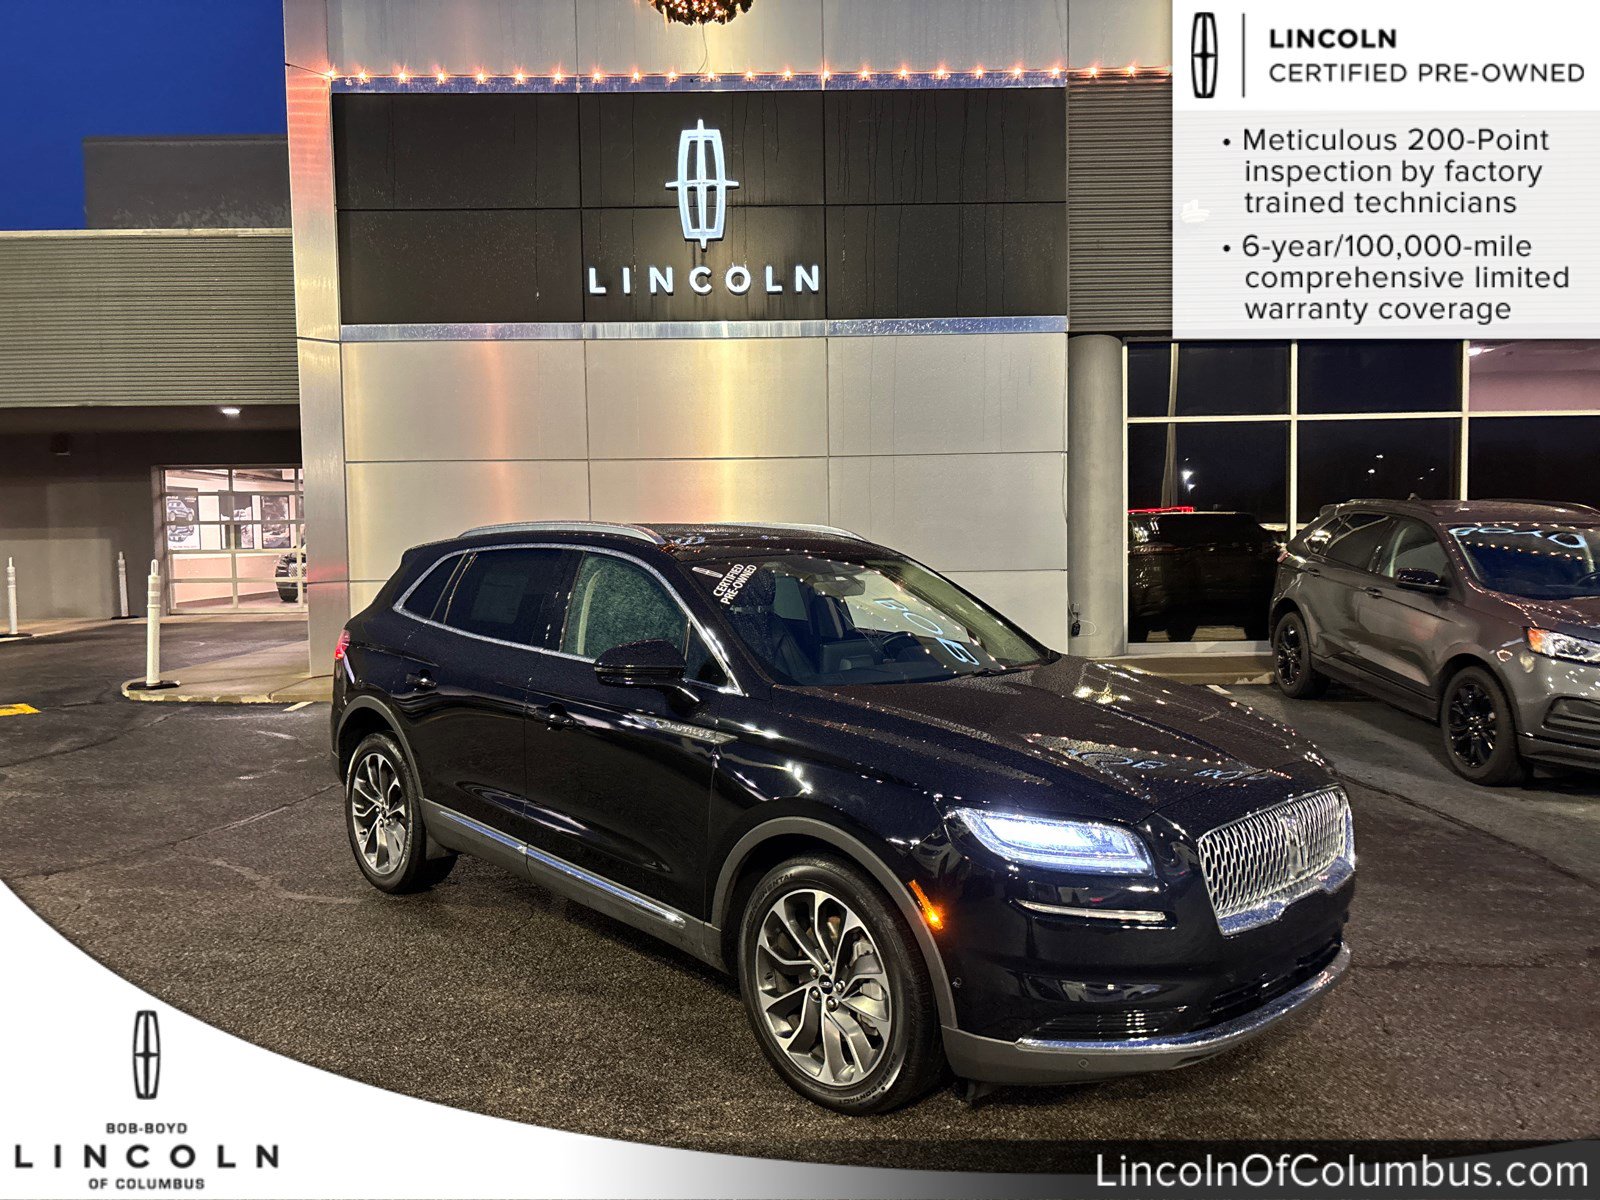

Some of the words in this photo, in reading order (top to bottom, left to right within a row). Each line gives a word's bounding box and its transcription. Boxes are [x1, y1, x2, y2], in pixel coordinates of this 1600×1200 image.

[588, 265, 819, 295] LINCOLN
[712, 563, 745, 597] CERTIFIED
[719, 564, 758, 605] PRE-OWNED
